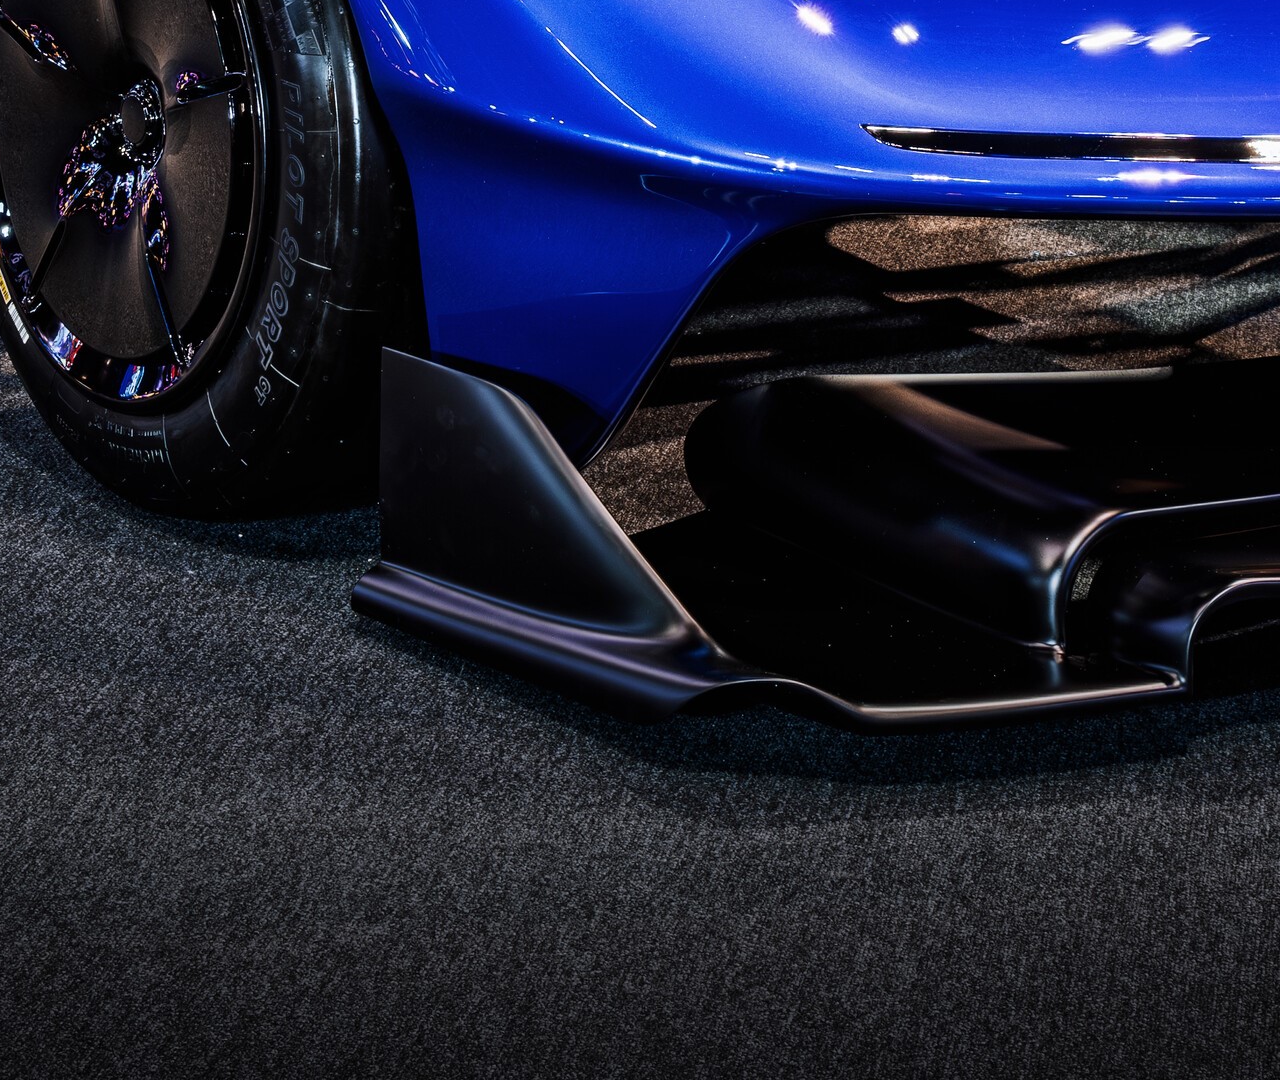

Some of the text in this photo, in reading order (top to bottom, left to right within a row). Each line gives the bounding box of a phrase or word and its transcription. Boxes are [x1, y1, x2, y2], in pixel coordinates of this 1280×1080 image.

[280, 78, 306, 225] PILOT
[255, 227, 300, 371] SPORT
[253, 375, 271, 407] GT
